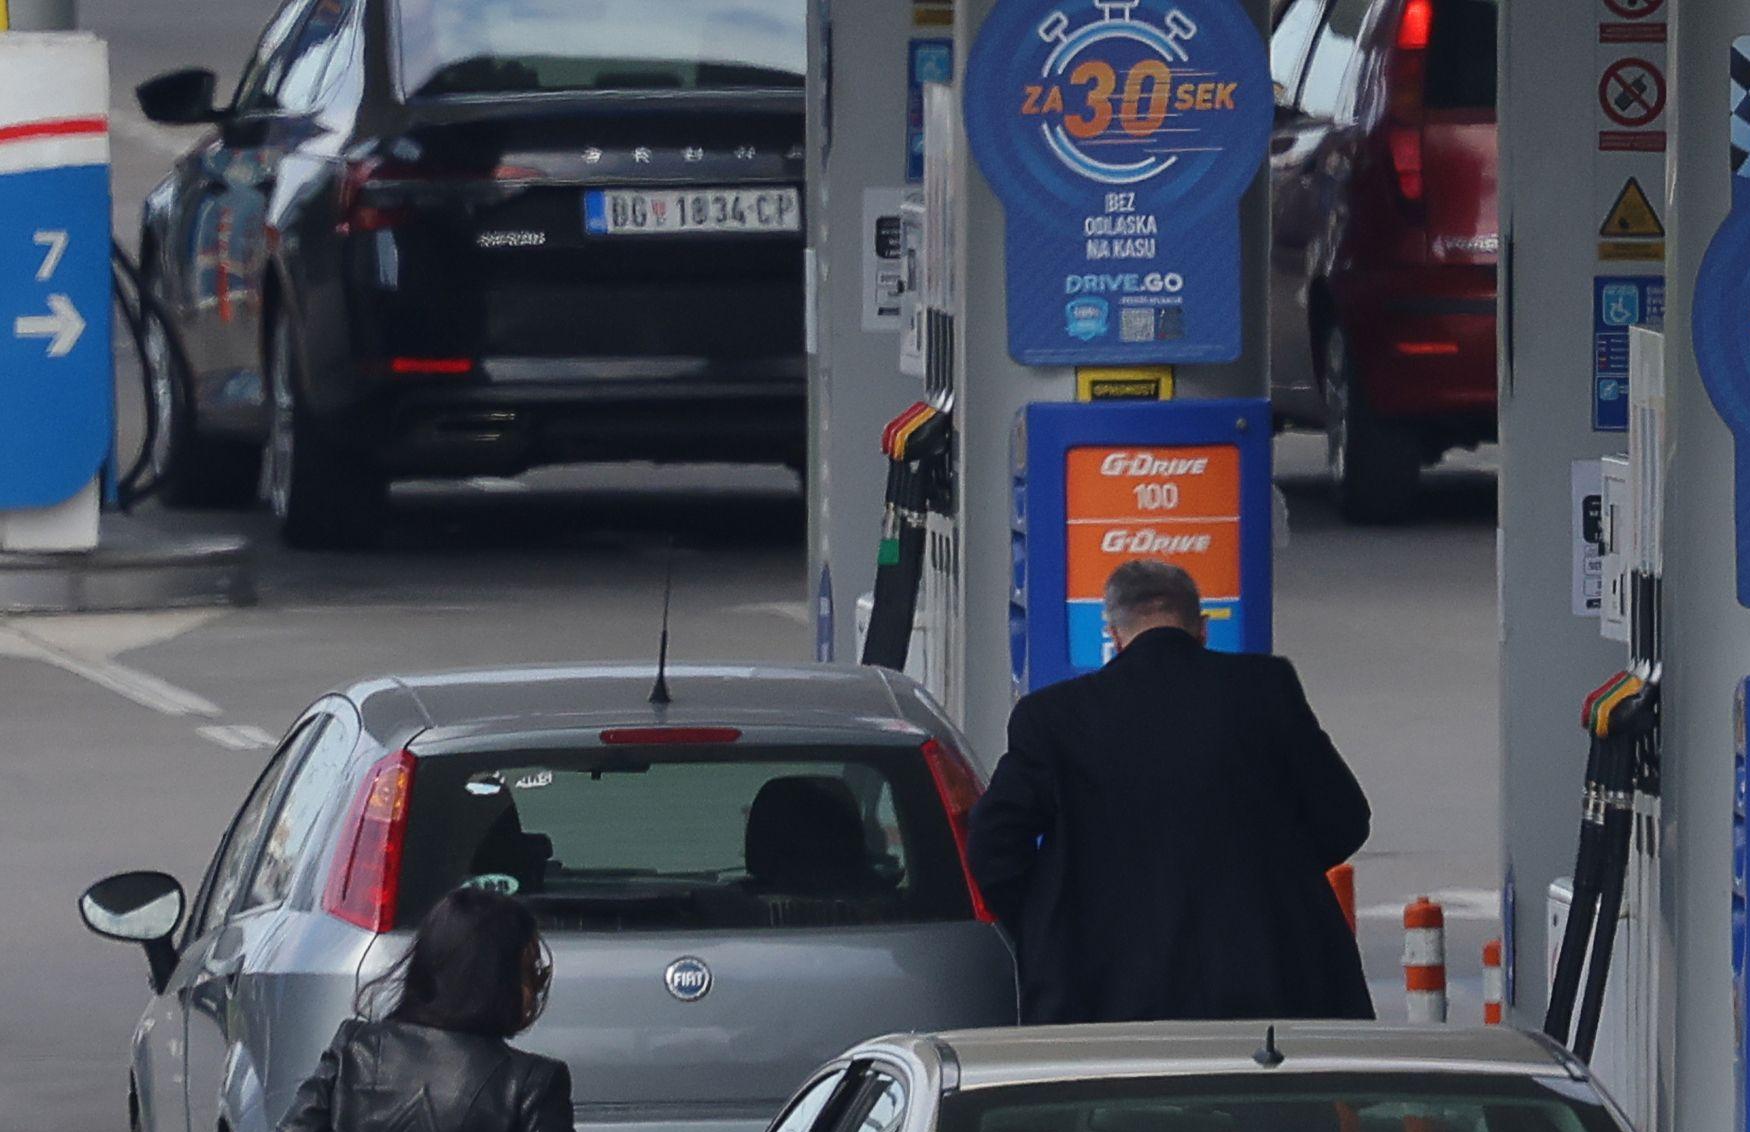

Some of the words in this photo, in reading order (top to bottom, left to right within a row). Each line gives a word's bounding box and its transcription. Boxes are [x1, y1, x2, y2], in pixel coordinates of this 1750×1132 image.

[1021, 84, 1063, 115] ZA
[1063, 59, 1172, 138] 30
[1174, 82, 1238, 111] SEK
[1105, 191, 1136, 212] BEZ
[1085, 215, 1157, 235] ODLASKA
[34, 231, 68, 281] 7
[1087, 239, 1110, 260] NA
[1113, 238, 1155, 259] KASU
[1066, 272, 1183, 293] DRIVE.GO
[1134, 483, 1179, 509] 100
[673, 970, 703, 987] FIAT
